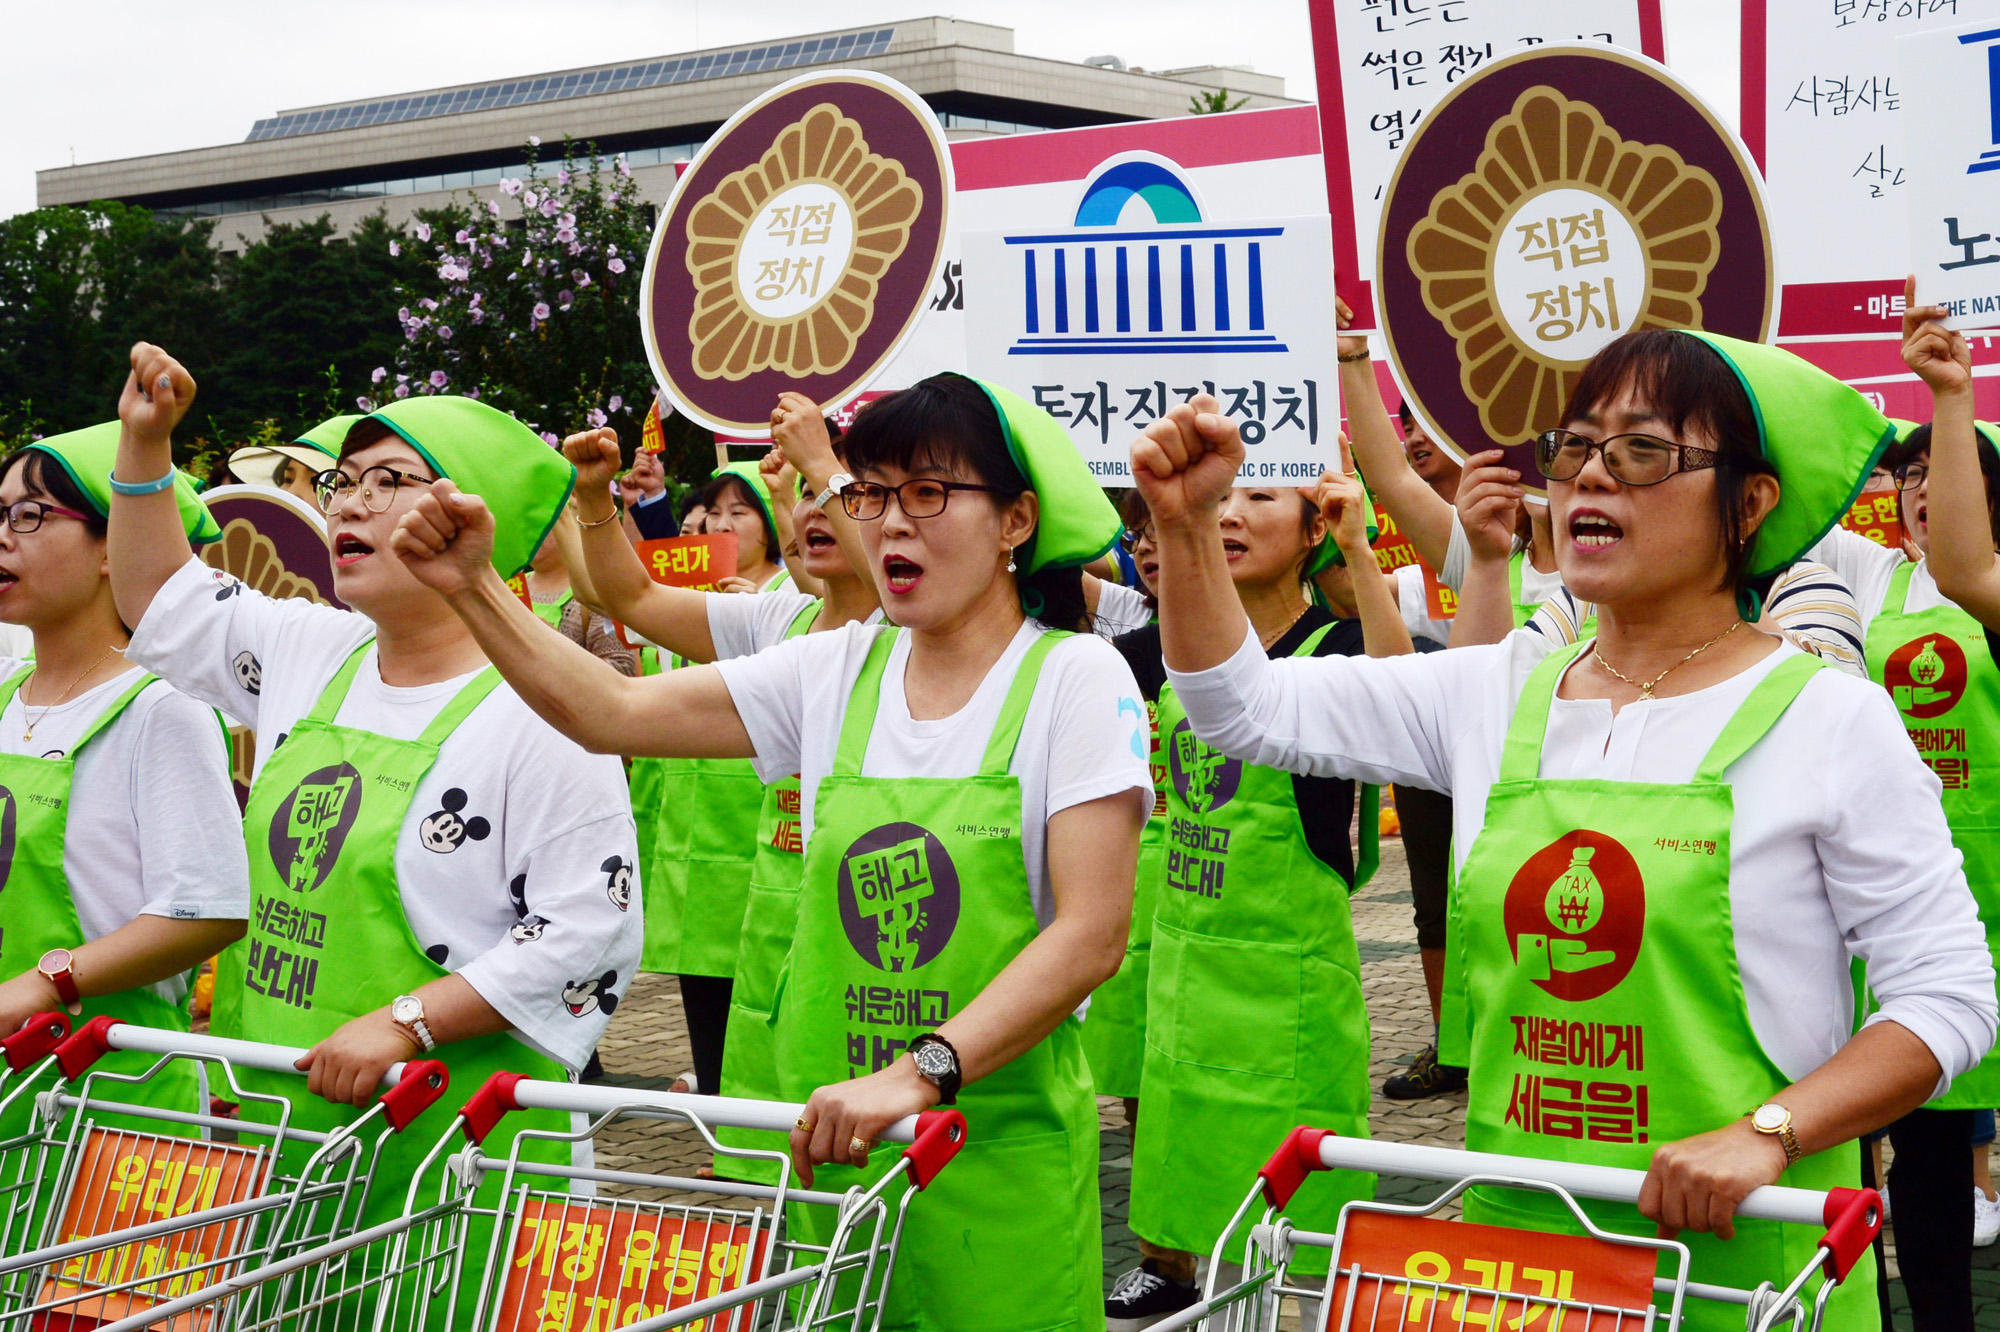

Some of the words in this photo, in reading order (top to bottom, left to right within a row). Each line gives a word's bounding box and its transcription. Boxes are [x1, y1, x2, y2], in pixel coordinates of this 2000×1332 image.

[1361, 49, 1427, 90] 썩은
[1370, 109, 1421, 149] 열
[766, 202, 836, 247] 직접
[1515, 208, 1610, 271] 직접
[1939, 217, 2000, 271] 노
[754, 256, 824, 300] 정치
[1526, 277, 1620, 341] 정치
[1260, 463, 1276, 477] OF
[1281, 463, 1325, 477] KOREA
[652, 545, 710, 577] 우리가
[1918, 654, 1936, 664] TAX
[296, 784, 346, 830] 해고
[955, 824, 1011, 839] 서비스연맹
[1171, 816, 1230, 855] 쉬운해고
[1653, 837, 1717, 856] 서비스연맹
[858, 847, 928, 901] 해고
[1167, 848, 1225, 899] 반대!
[1563, 875, 1592, 893] TAX
[174, 907, 196, 918] Disney
[255, 893, 327, 949] 쉬운해고
[245, 937, 319, 1010] 반대!
[845, 984, 949, 1027] 쉬운해고
[1510, 1015, 1644, 1072] 재벌에게
[1504, 1072, 1649, 1144] 세금을!
[515, 1217, 604, 1282] 가장
[619, 1229, 749, 1300] 유능한
[1393, 1250, 1576, 1332] 우리가
